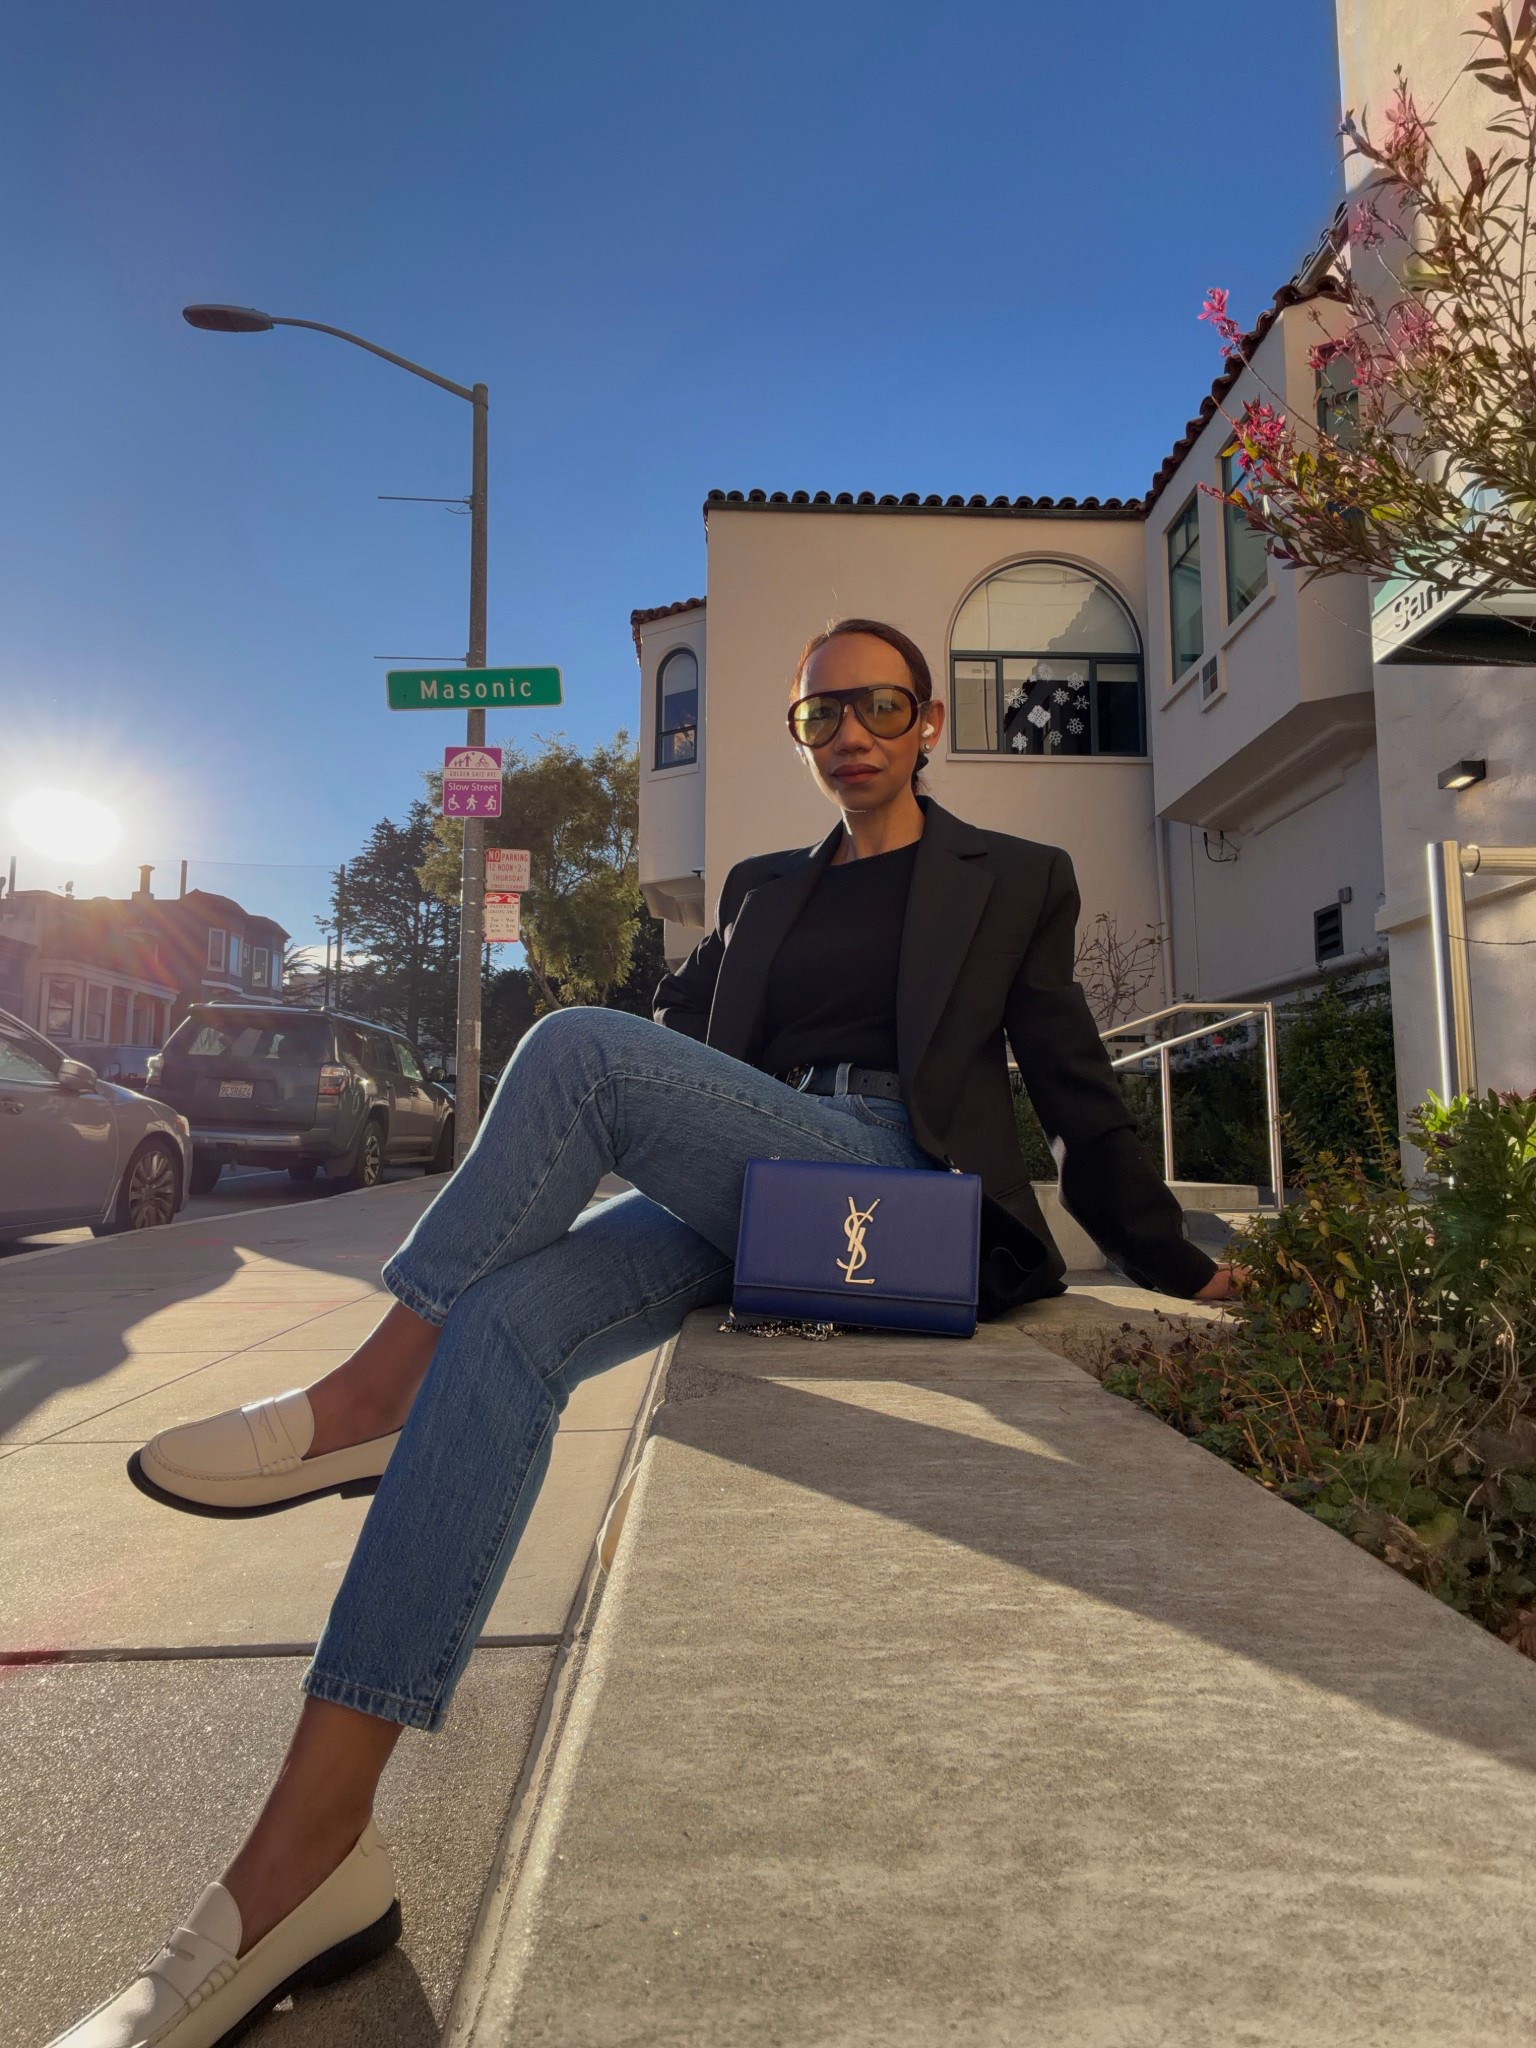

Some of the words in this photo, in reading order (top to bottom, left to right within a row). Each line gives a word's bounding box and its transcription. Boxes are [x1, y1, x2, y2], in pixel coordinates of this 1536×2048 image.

[420, 678, 532, 700] Masonic
[448, 782, 470, 791] Slow
[471, 783, 498, 792] Street
[488, 850, 500, 861] NO
[502, 853, 529, 863] PARKING
[489, 864, 496, 872] 12
[493, 874, 524, 882] THURSDAY
